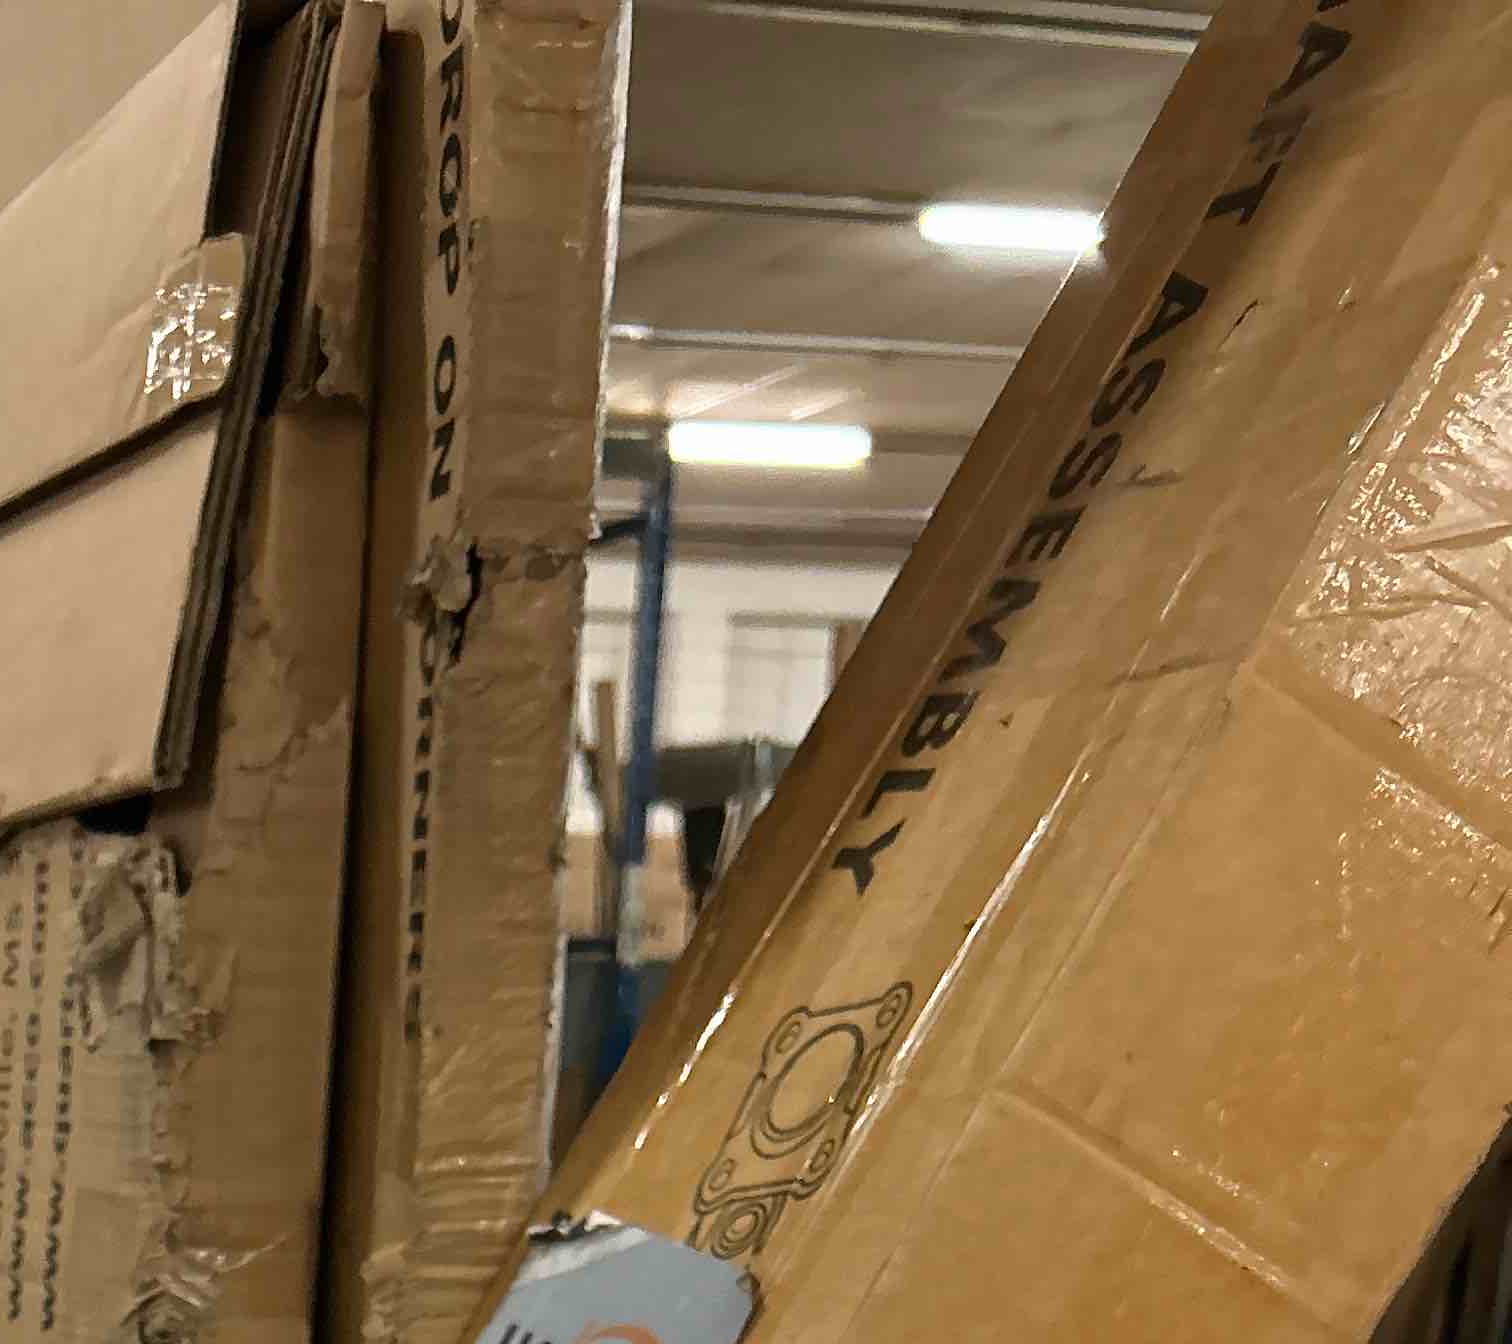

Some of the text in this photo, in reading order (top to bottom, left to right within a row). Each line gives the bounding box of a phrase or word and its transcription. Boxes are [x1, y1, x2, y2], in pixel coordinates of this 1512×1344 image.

[430, 335, 457, 500] ON
[832, 271, 1209, 896] ASSEMBLY
[404, 606, 439, 1041] ORNERS
